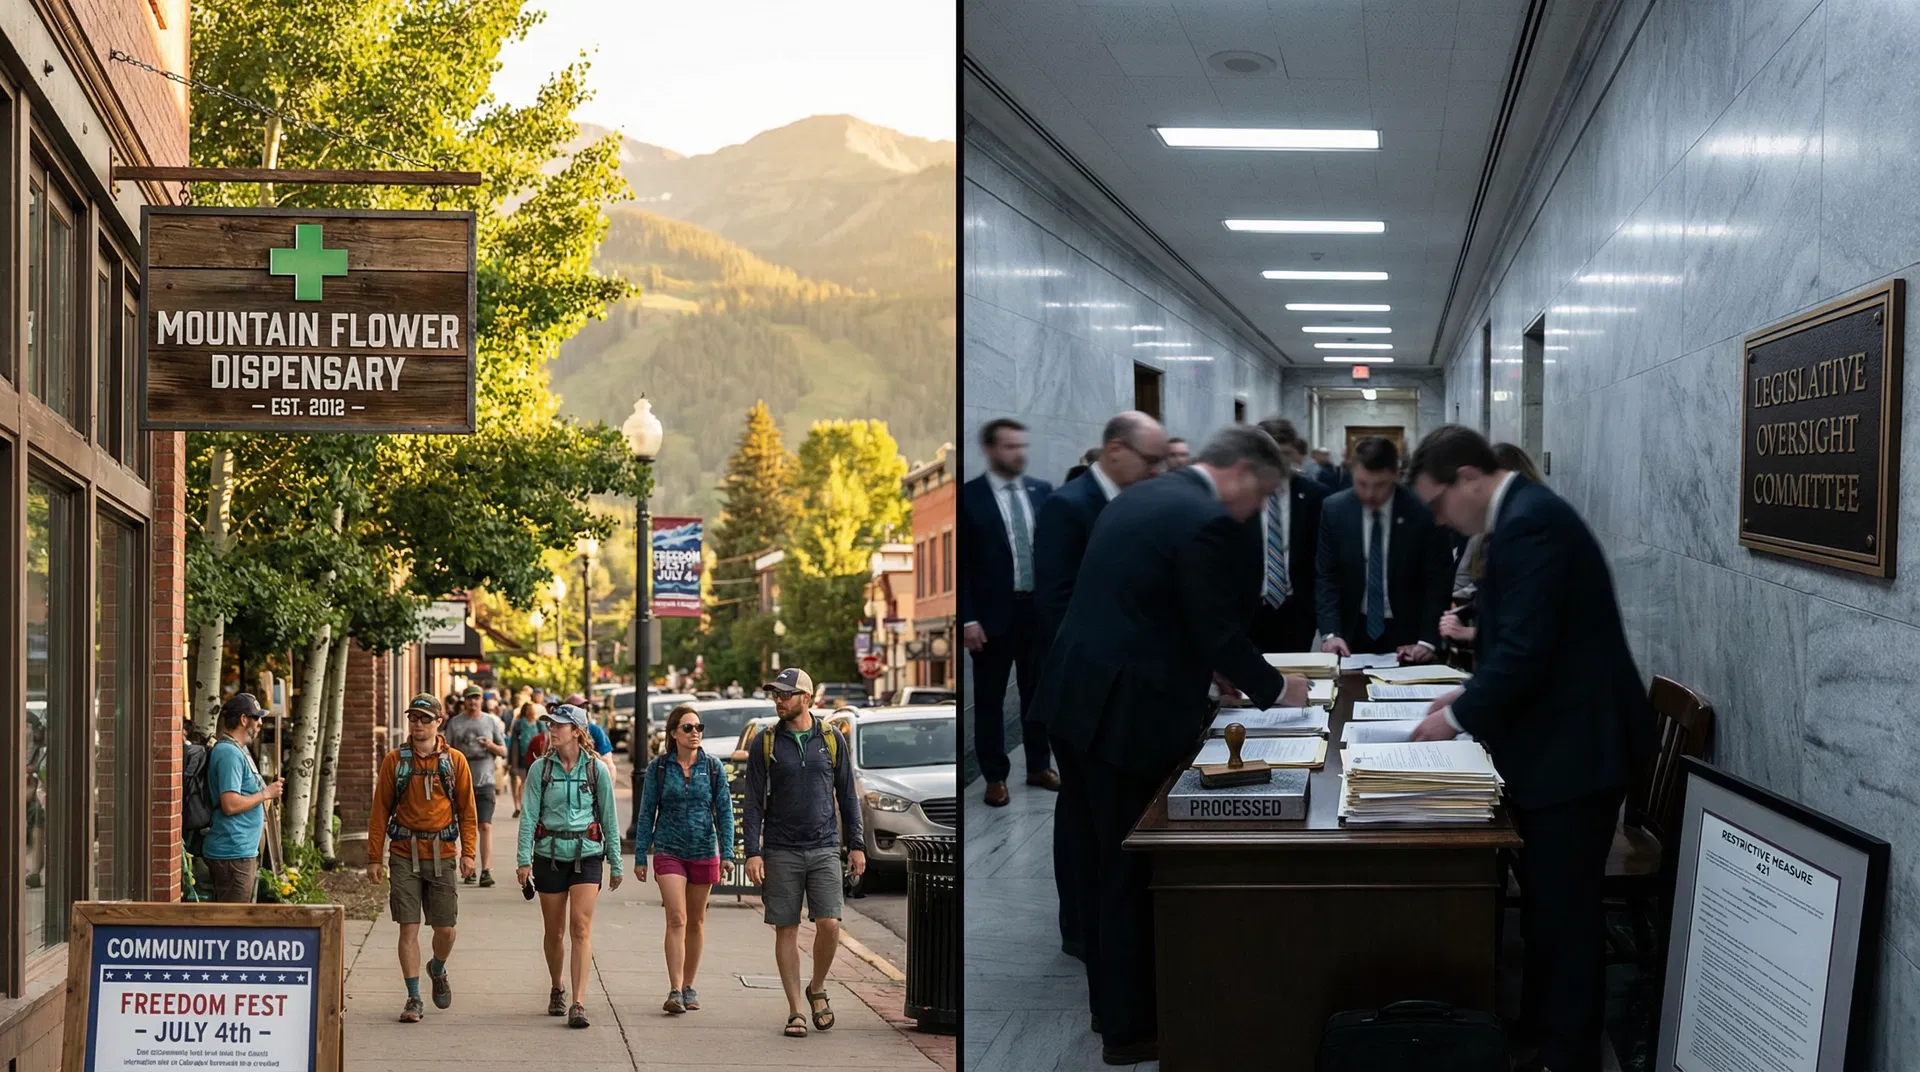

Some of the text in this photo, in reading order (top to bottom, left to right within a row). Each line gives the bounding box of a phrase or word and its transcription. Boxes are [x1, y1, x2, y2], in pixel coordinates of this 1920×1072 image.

[157, 310, 459, 349] MOUNTAIN FLOWER
[211, 354, 406, 391] DISPENSARY
[1754, 352, 1867, 408] LEGISLATIVE
[271, 398, 345, 416] EST. 2012
[1756, 414, 1859, 455] OVERSIGHT
[1753, 473, 1860, 513] COMMITTEE
[653, 550, 701, 563] FREEDOM
[657, 570, 684, 580] JULY
[1190, 799, 1281, 817] PROCESSED
[1722, 830, 1814, 886] RESTRICTIVE MEASURE
[1756, 862, 1770, 877] 421
[107, 938, 305, 961] COMMUNITY BOARD
[121, 992, 288, 1017] FREEDOM FEST
[154, 1021, 251, 1044] JULY 4th
